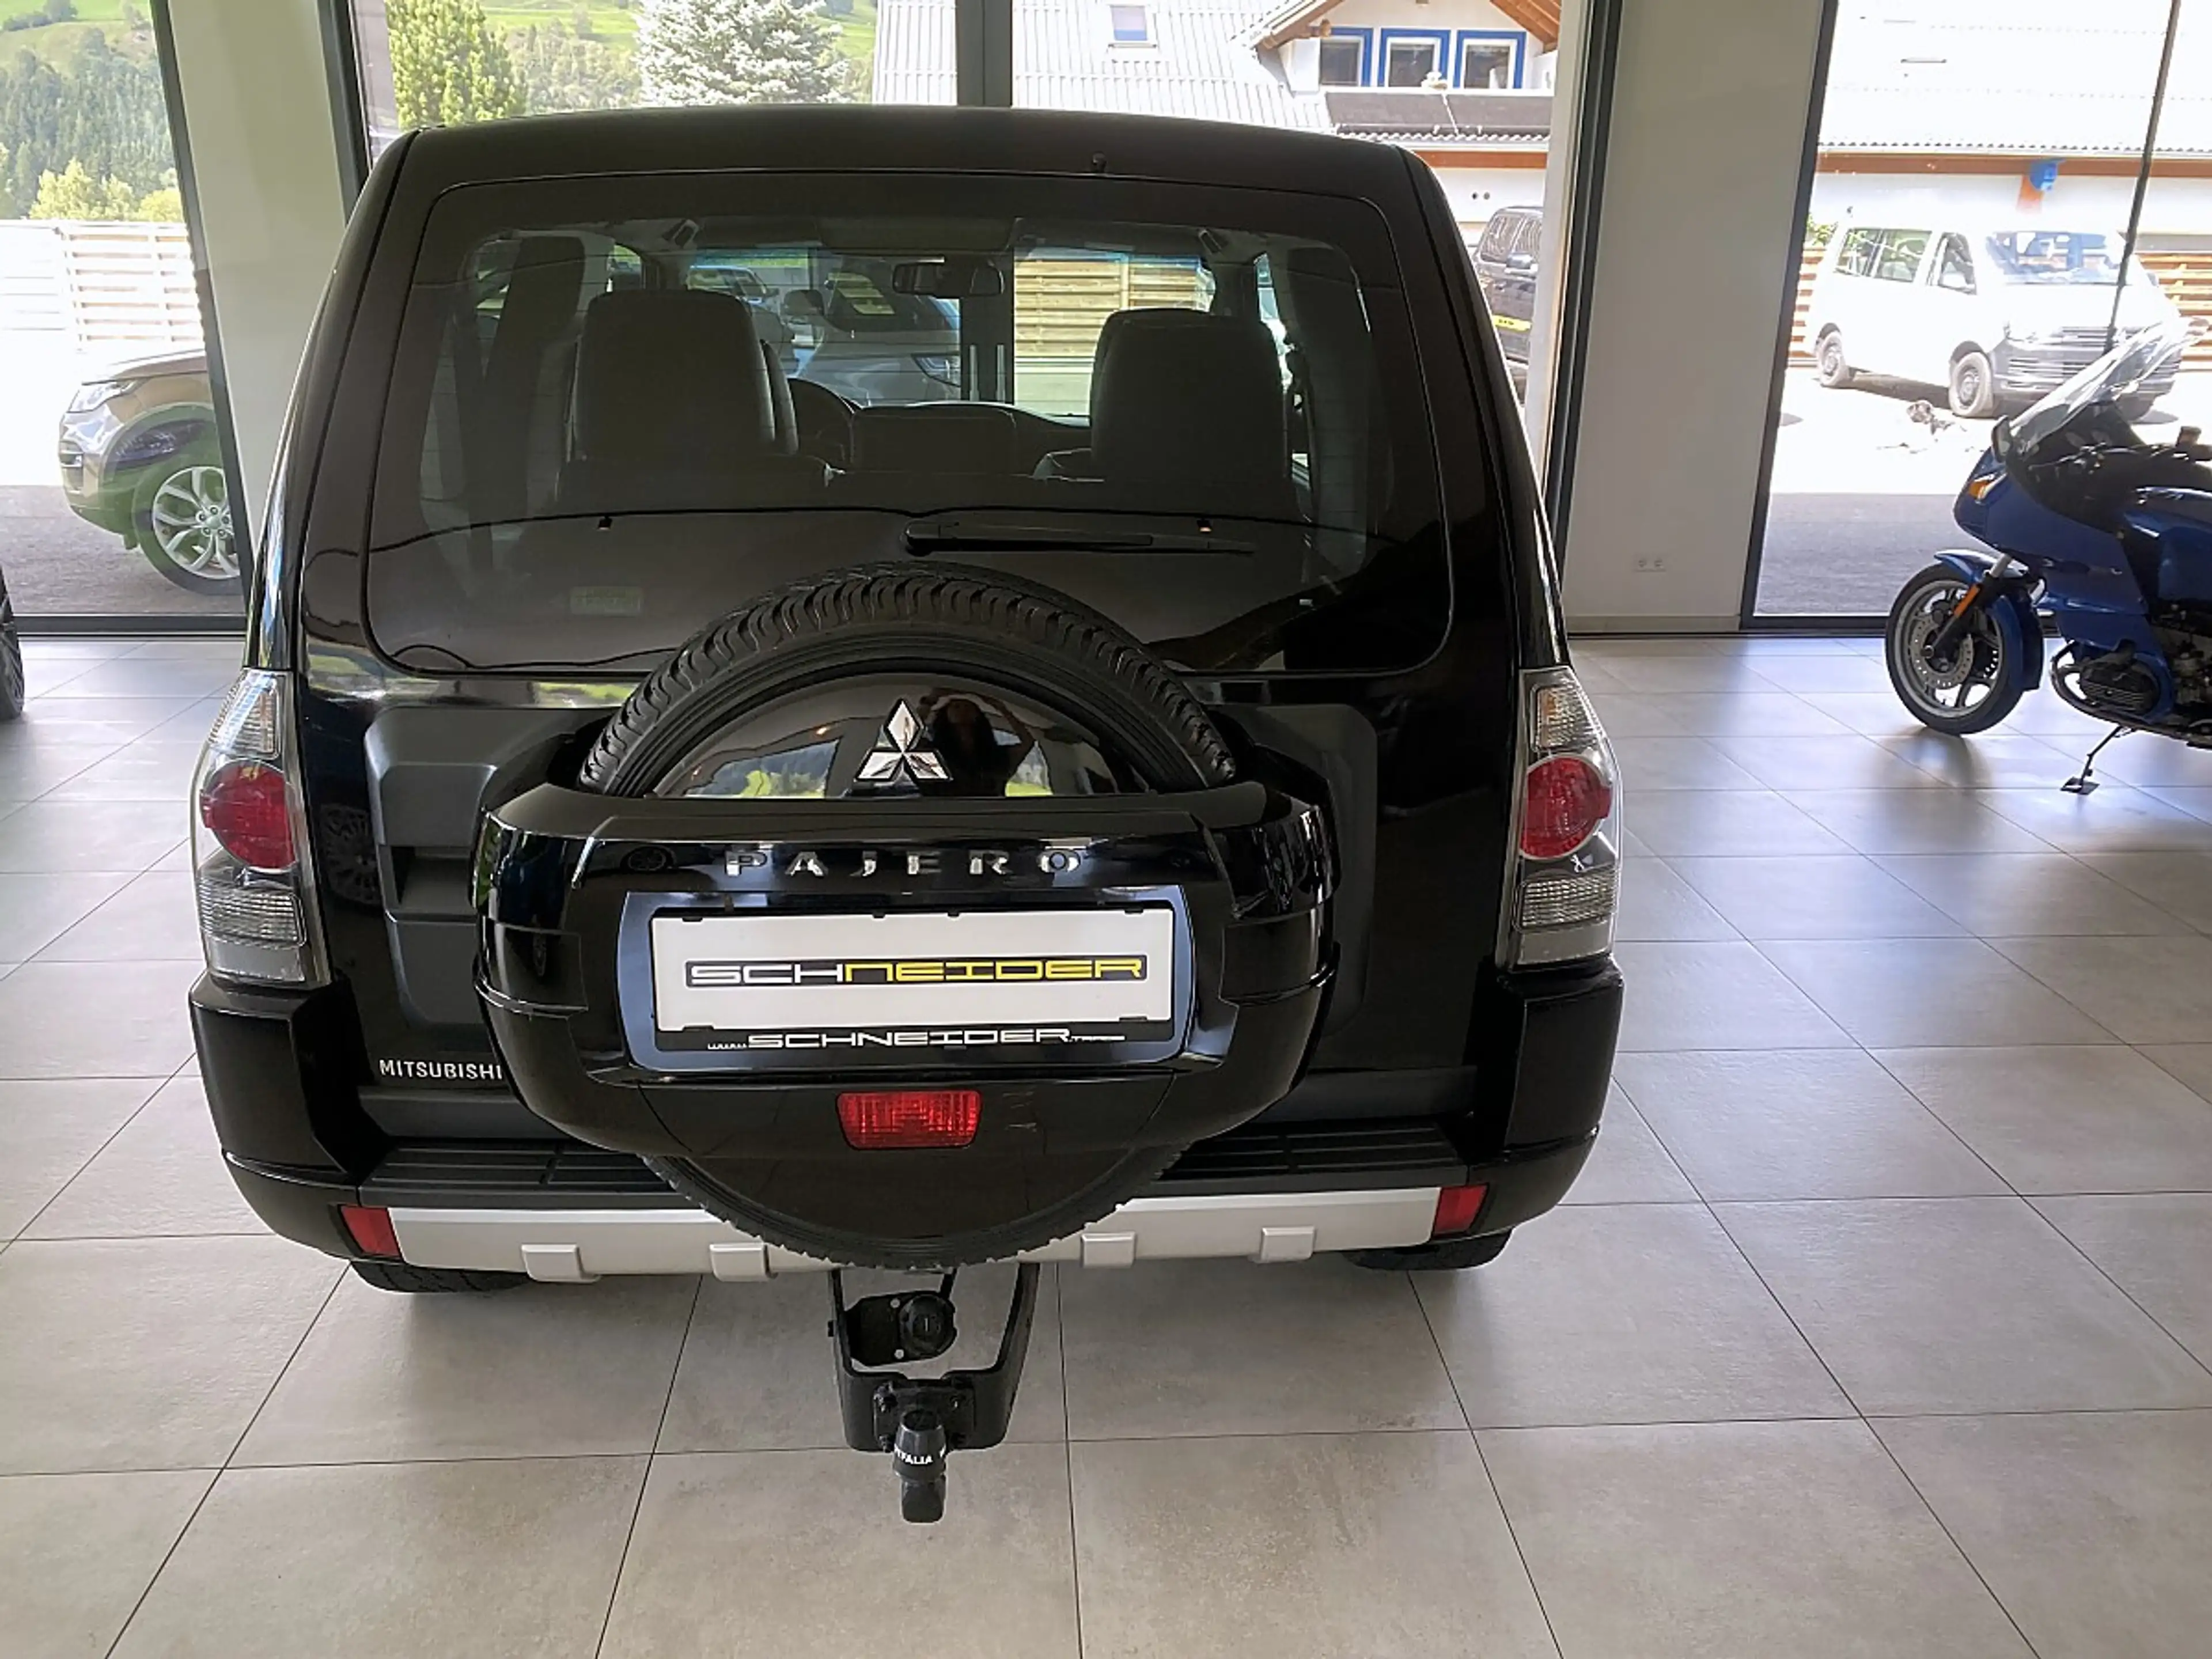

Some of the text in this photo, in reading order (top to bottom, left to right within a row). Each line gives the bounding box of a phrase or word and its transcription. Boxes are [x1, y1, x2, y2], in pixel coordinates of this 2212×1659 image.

[725, 850, 1081, 877] PAJERO
[689, 959, 1143, 984] SCHNEIDER
[379, 1059, 502, 1080] MITSUBISHI
